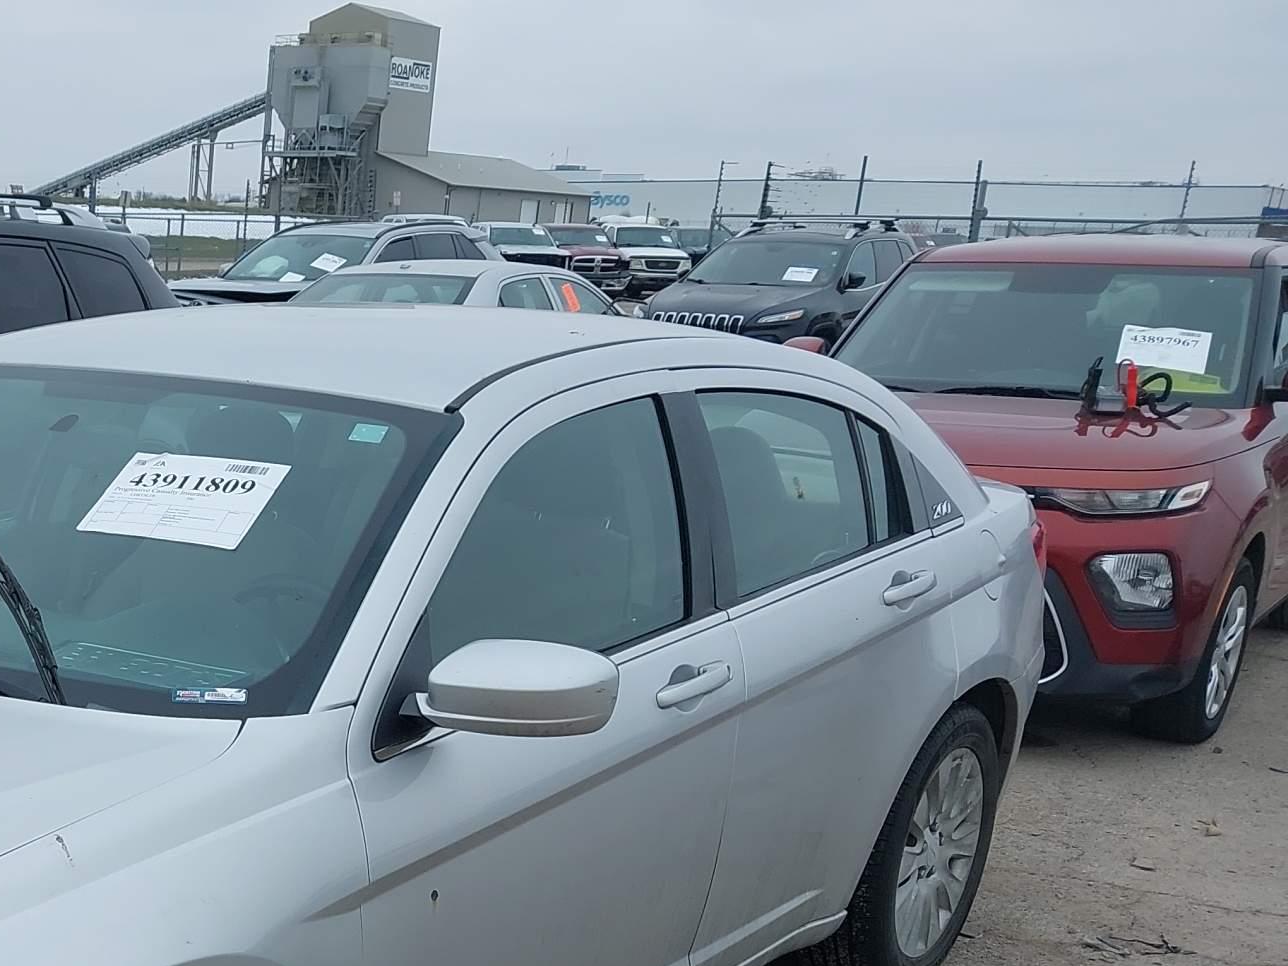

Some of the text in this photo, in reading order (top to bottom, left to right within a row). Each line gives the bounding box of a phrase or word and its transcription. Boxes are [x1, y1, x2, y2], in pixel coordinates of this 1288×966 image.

[391, 62, 430, 80] ROANOKE
[590, 191, 630, 209] Sysco
[1130, 334, 1200, 348] 43897967
[129, 472, 257, 495] 43911809
